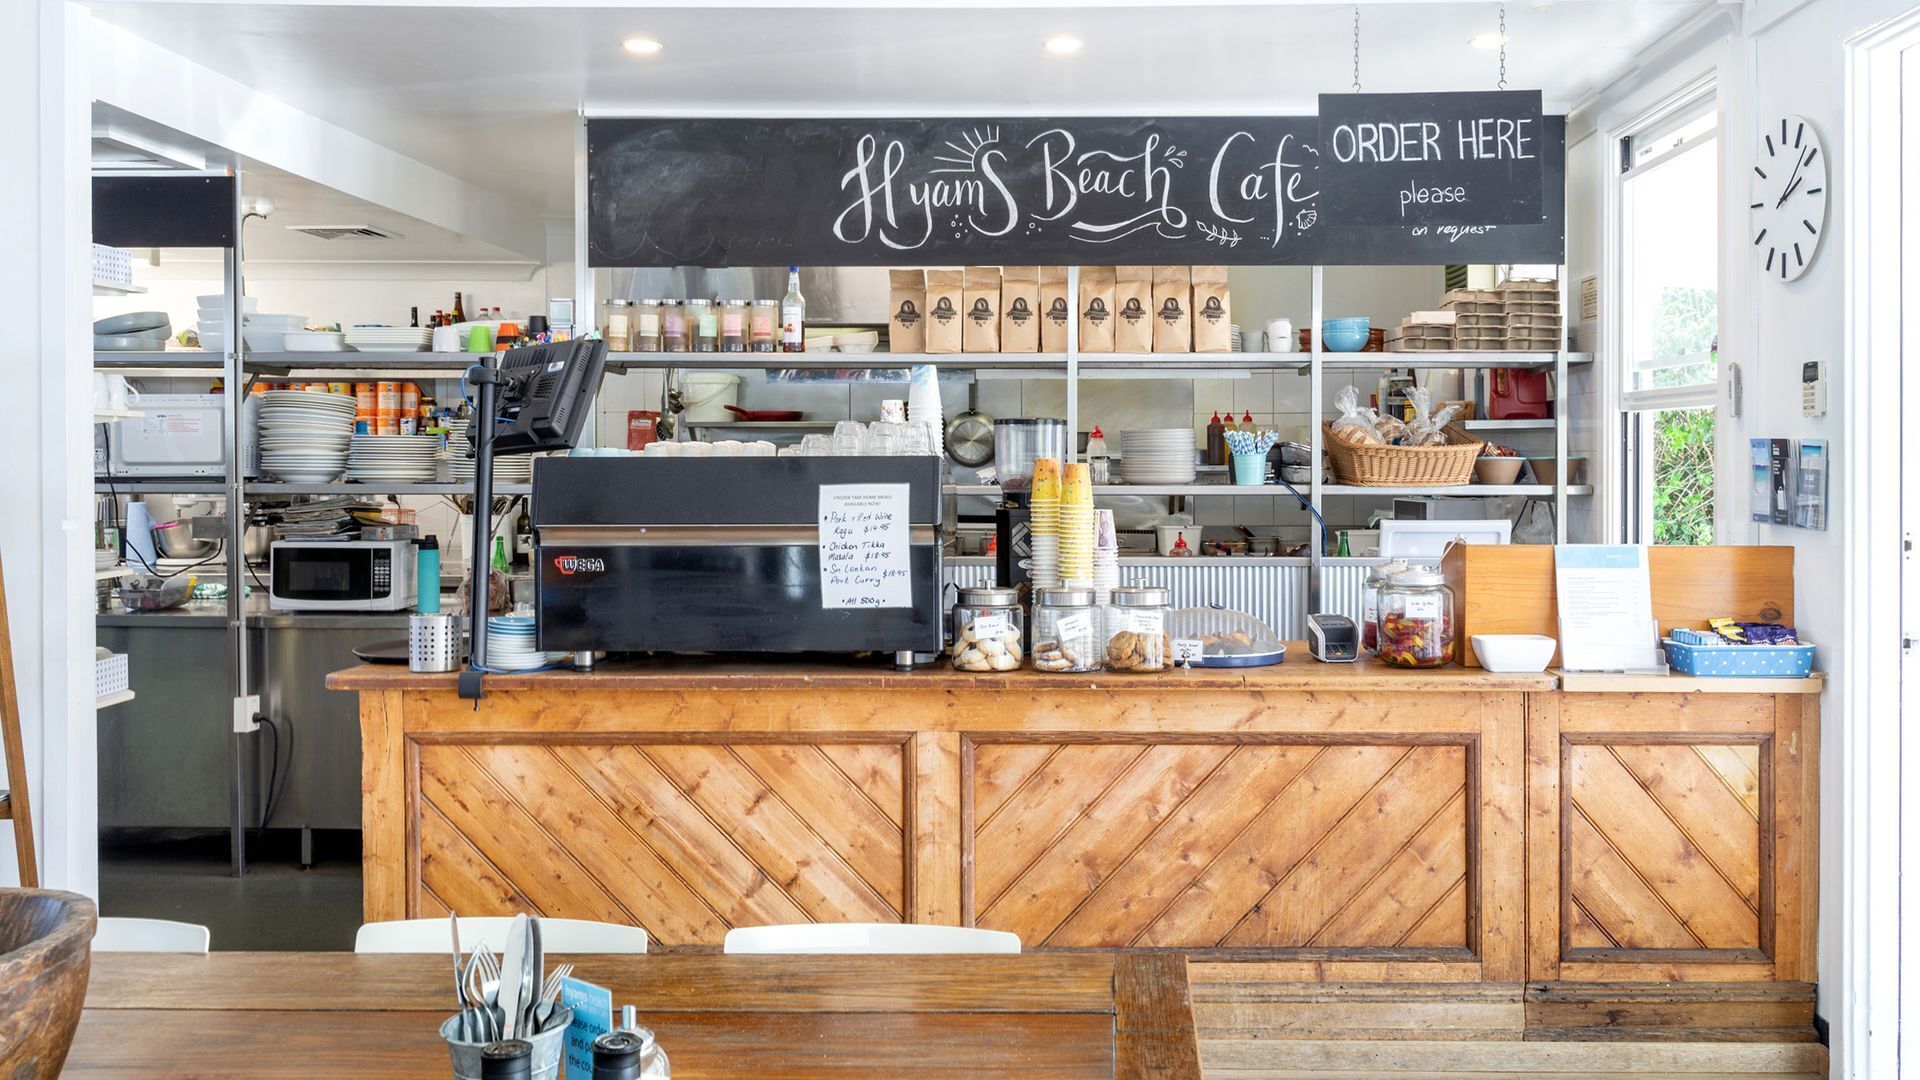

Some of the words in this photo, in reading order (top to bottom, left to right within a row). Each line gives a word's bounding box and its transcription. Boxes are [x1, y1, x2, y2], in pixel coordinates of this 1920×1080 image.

[1333, 122, 1441, 162] ORDER
[1458, 118, 1535, 160] HERE
[1026, 129, 1187, 228] Beach
[1400, 180, 1466, 217] please
[1437, 225, 1497, 243] request
[875, 511, 892, 521] Wine
[829, 541, 858, 551] Chicken
[862, 541, 885, 549] Tikka
[828, 552, 854, 561] Masala
[562, 558, 605, 572] WEGA
[844, 564, 877, 573] Lankan
[854, 575, 881, 588] Curry
[845, 597, 857, 605] All
[568, 1054, 581, 1069] the
